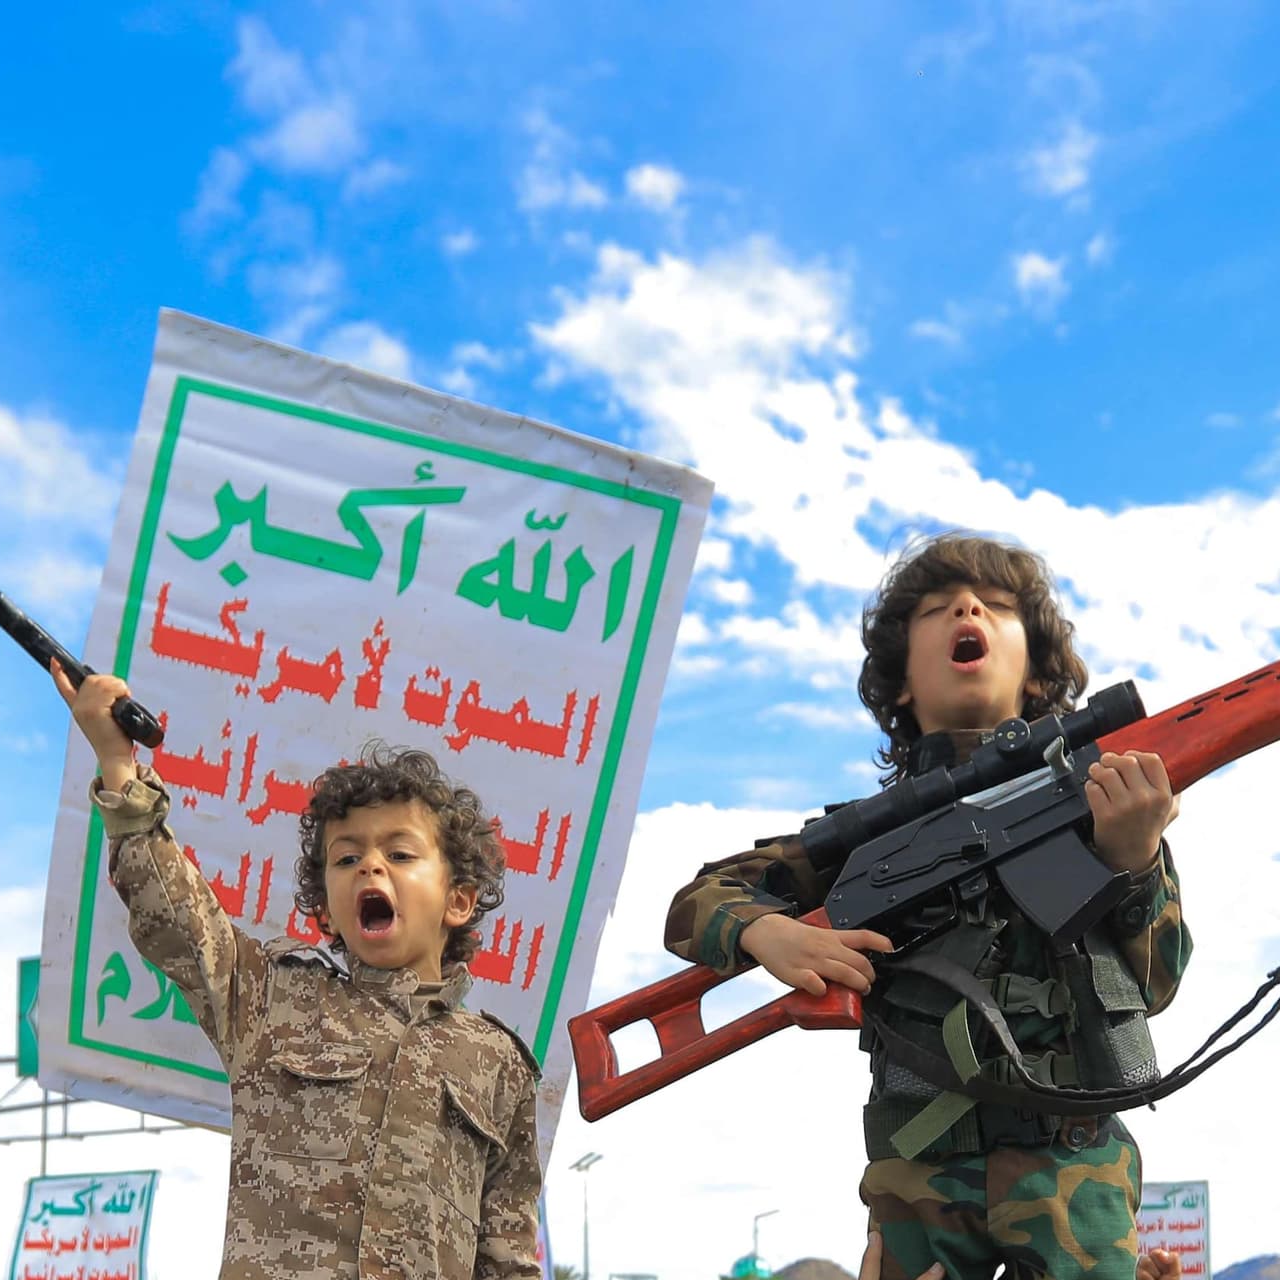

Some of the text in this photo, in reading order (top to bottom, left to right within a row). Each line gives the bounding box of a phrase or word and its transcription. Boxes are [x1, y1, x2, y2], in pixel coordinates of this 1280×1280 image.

[166, 461, 635, 642] الله أكبر
[150, 582, 599, 766] الموت لأمريكا
[29, 1179, 148, 1227] الله أكبر
[93, 1226, 139, 1256] الموت
